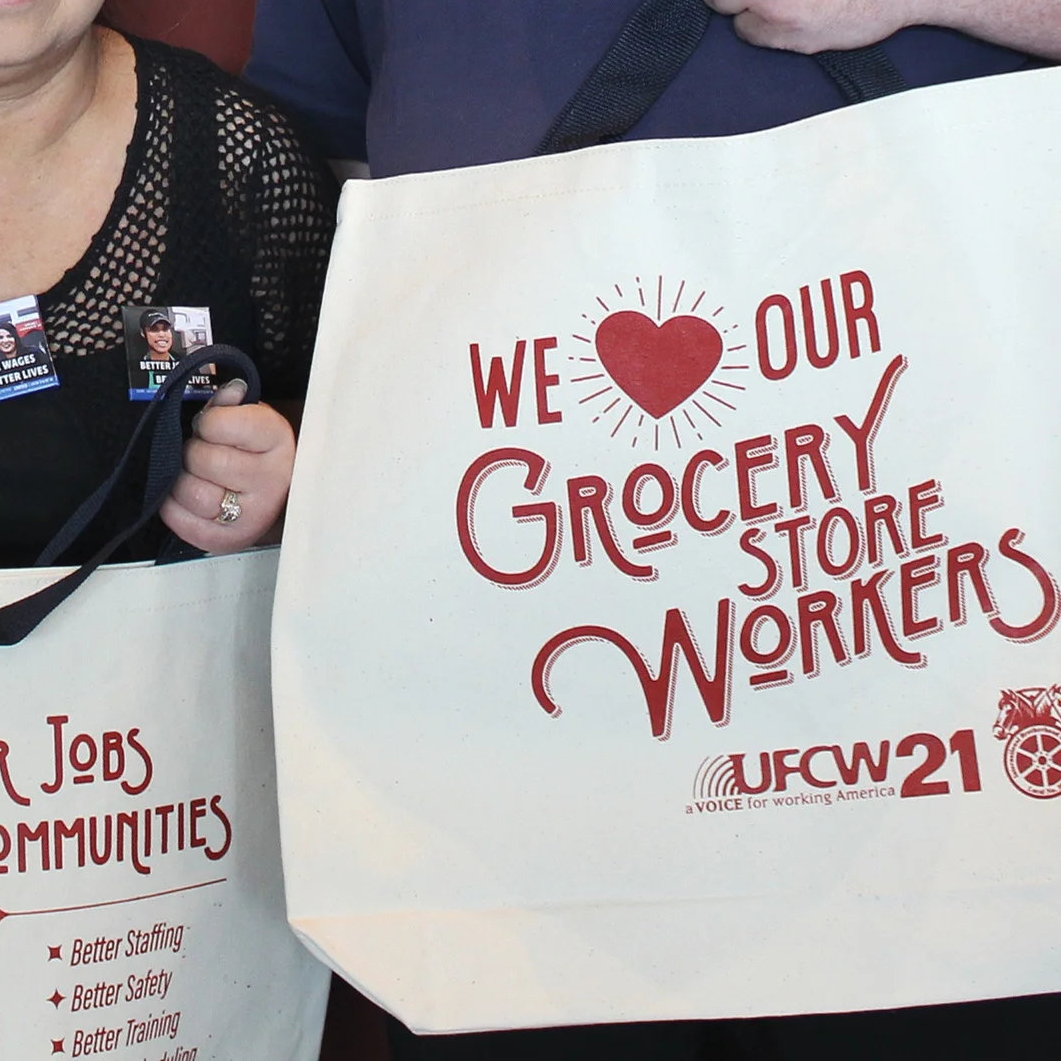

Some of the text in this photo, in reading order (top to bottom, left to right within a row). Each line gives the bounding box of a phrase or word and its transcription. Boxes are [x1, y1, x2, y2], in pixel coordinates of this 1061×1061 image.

[1, 353, 36, 370] WAGES
[21, 364, 49, 380] LIVES
[139, 360, 172, 371] BETTER
[469, 270, 882, 429] WE OUR
[456, 354, 908, 591] GROCERY
[738, 479, 948, 601] STORE
[531, 527, 1061, 742] WORKERS
[40, 715, 154, 796] JOBS
[728, 729, 982, 798] UFCW 21
[685, 786, 896, 814] a VOICE for working America
[70, 922, 184, 966] Better Staffing
[71, 968, 174, 1012] Better Safety
[72, 1026, 123, 1058] Better
[125, 1009, 181, 1047] Training
